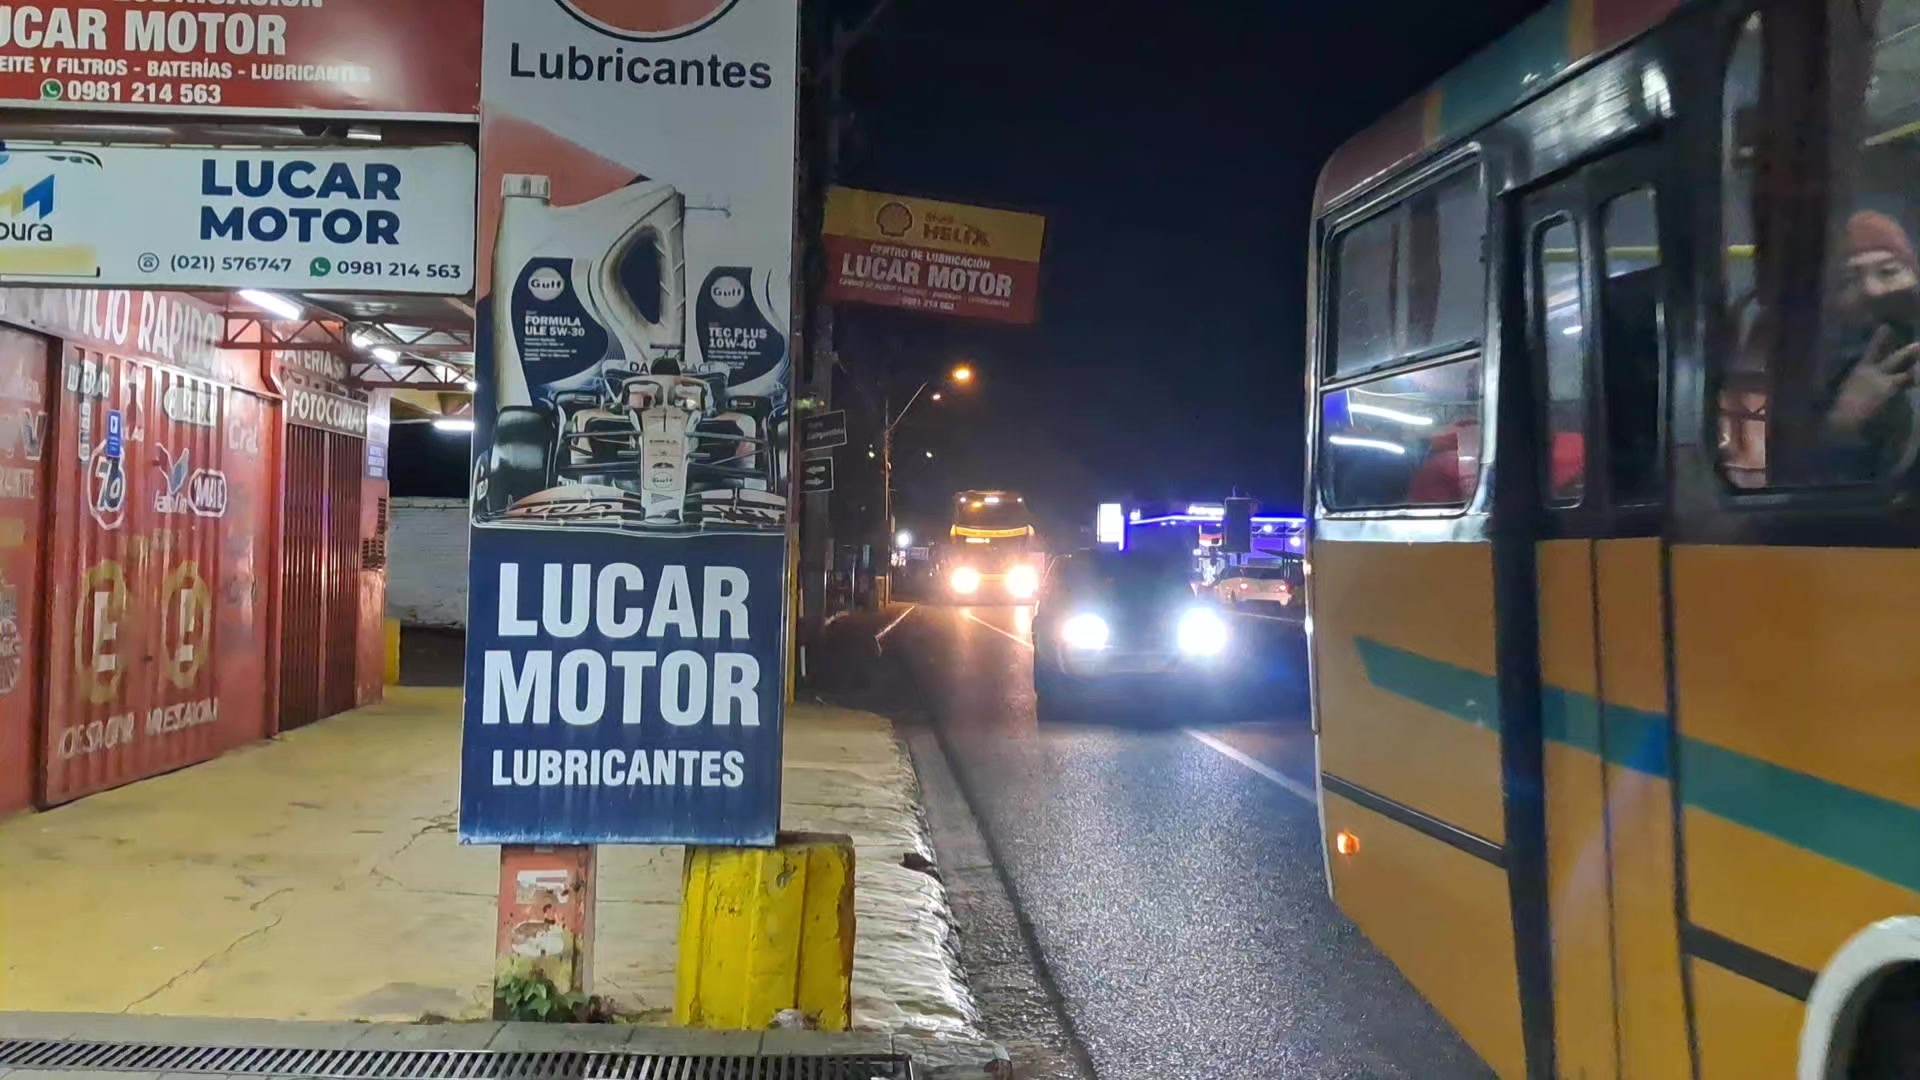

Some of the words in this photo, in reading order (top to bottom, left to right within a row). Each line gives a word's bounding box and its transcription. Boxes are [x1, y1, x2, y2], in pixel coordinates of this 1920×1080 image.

[124, 9, 287, 55] MOTOR
[40, 56, 52, 74] Y
[57, 57, 128, 76] FILTROS
[147, 58, 232, 79] BATERÍAS
[510, 42, 772, 89] Lubricantes
[67, 80, 121, 101] 0981
[131, 82, 173, 103] 214
[180, 84, 221, 104] 563
[201, 158, 402, 201] LUCAR
[200, 205, 400, 245] MOTOR
[170, 254, 216, 273] (021)
[222, 255, 292, 274] 576747
[337, 260, 383, 276] 0981
[388, 261, 421, 278] 214
[426, 263, 461, 280] 563
[870, 243, 909, 259] CENTRO
[911, 250, 924, 261] DE
[841, 253, 920, 287] LUCAR
[927, 264, 1014, 298] MOTOR
[525, 315, 581, 326] FORMULA
[525, 325, 547, 336] ULE
[549, 326, 585, 337] 5W-30
[709, 327, 732, 338] TEC
[734, 328, 768, 339] PLUS
[709, 337, 757, 349] 10W-40
[290, 388, 366, 433] FOTOCOPIAS
[497, 561, 750, 640] LUCAR
[482, 649, 761, 727] MOTOR
[491, 749, 745, 788] LUBRICANTES
